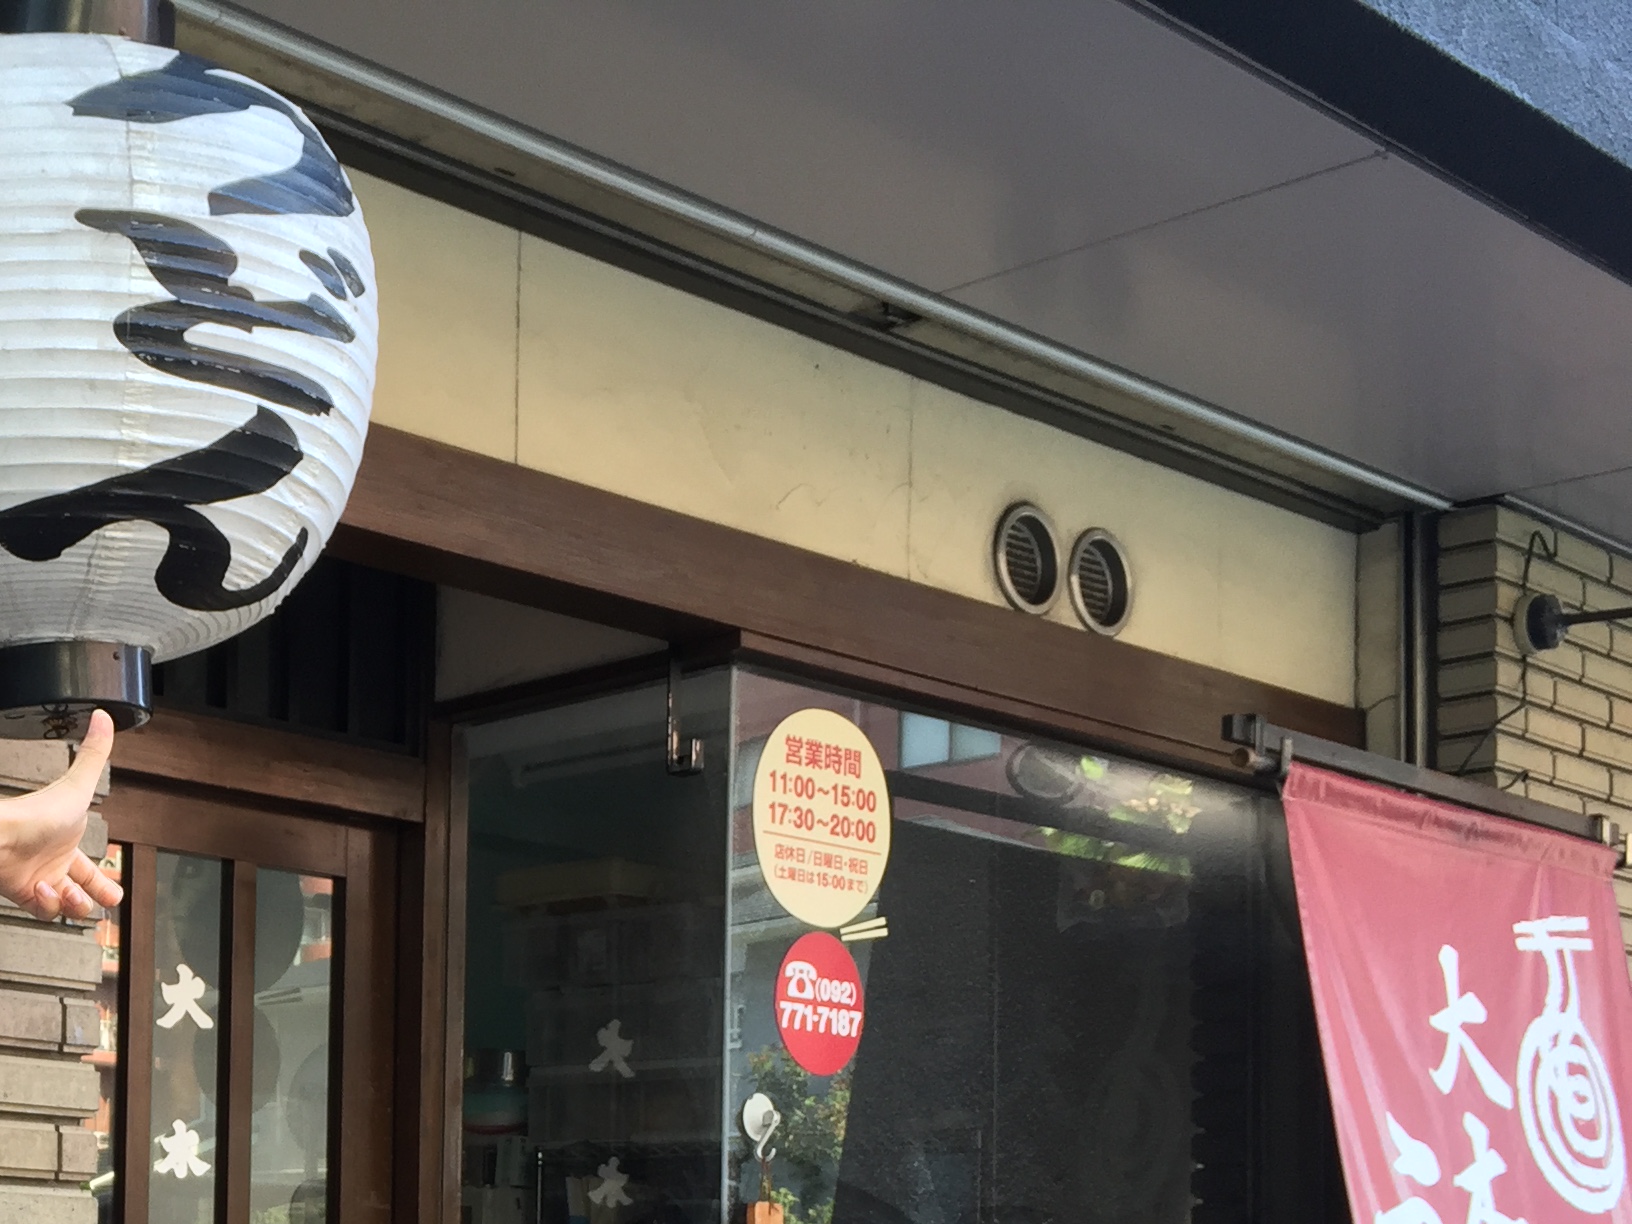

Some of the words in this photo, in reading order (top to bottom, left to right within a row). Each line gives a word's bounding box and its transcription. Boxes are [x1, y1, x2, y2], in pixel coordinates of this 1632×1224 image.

[784, 735, 862, 779] 営業時間
[814, 977, 857, 1007] (092)
